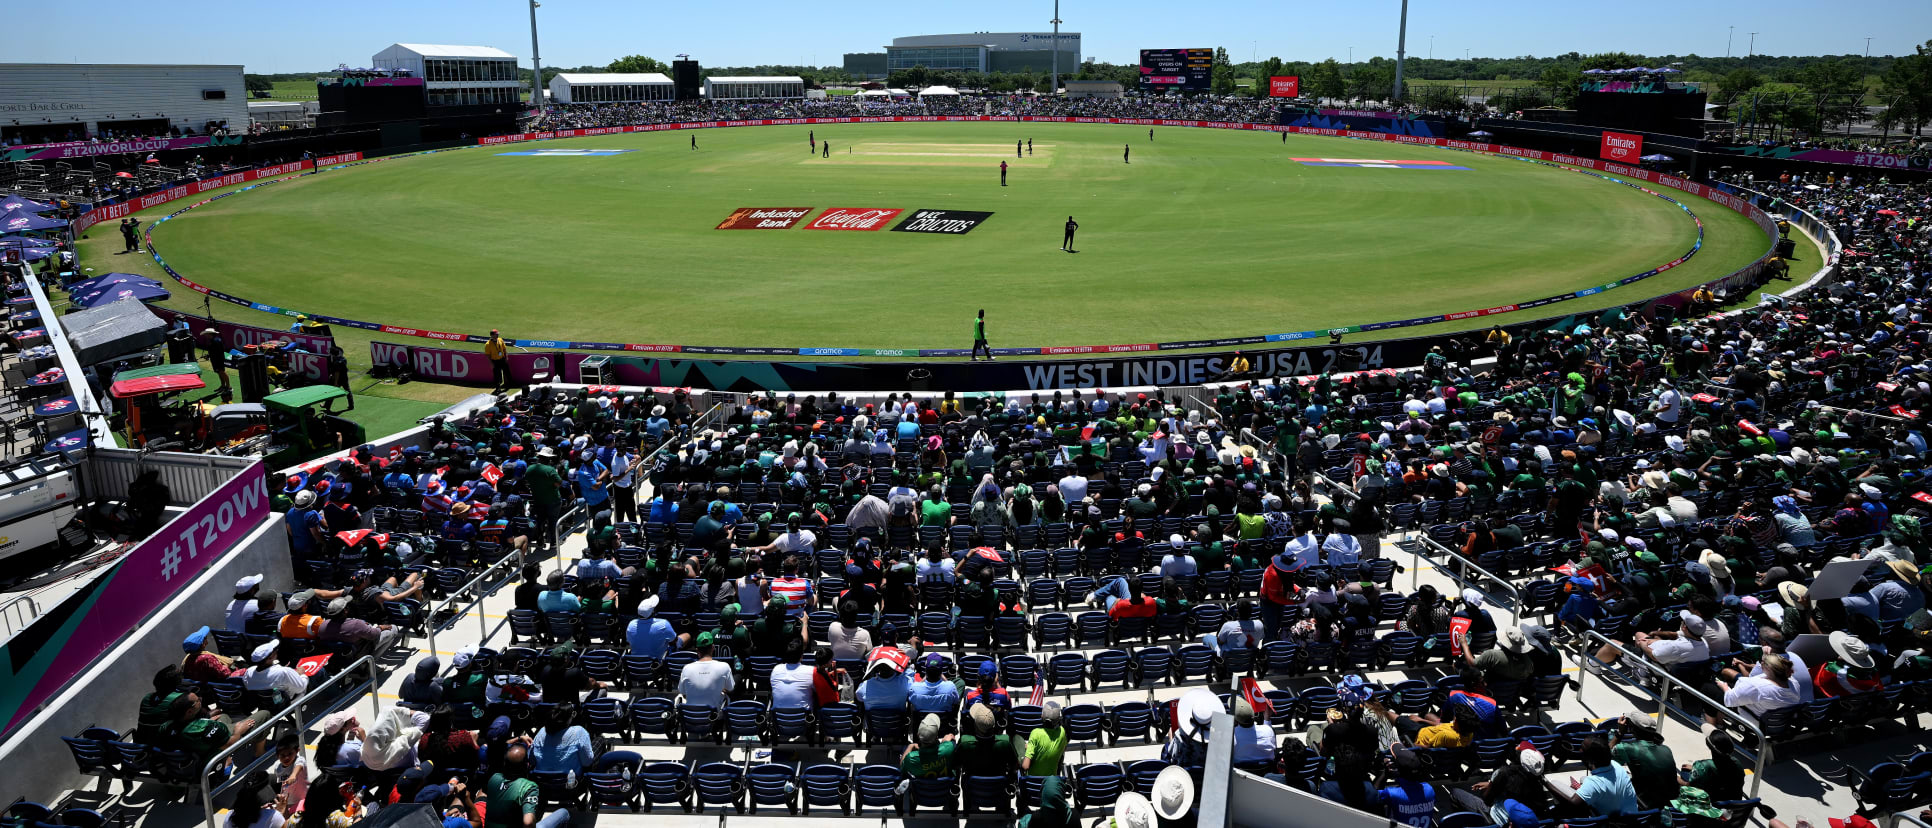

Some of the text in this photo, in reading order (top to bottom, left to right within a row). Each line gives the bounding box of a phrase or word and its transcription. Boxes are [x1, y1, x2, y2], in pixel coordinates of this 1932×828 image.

[63, 141, 170, 157] #T20WORLDCUP
[1606, 136, 1636, 150] Emirates
[1500, 146, 1522, 156] Emirates
[316, 156, 337, 167] mirates
[1552, 154, 1575, 164] Emirates
[256, 167, 281, 179] Emirates
[1604, 163, 1628, 175] Emirates
[1636, 168, 1648, 180] BETTER
[197, 177, 222, 192] Emirates
[1659, 174, 1682, 188] Emirates
[1688, 182, 1700, 194] BETTER
[141, 194, 167, 208] Emirates
[174, 186, 188, 197] BETTER
[750, 209, 804, 218] IndusInd
[756, 218, 792, 228] Bank
[906, 218, 975, 232] CRICTOS
[372, 343, 469, 378] WORLD
[1024, 346, 1384, 390] WEST INDIES USA 224
[488, 471, 499, 482] 4
[1452, 625, 1461, 648] 6
